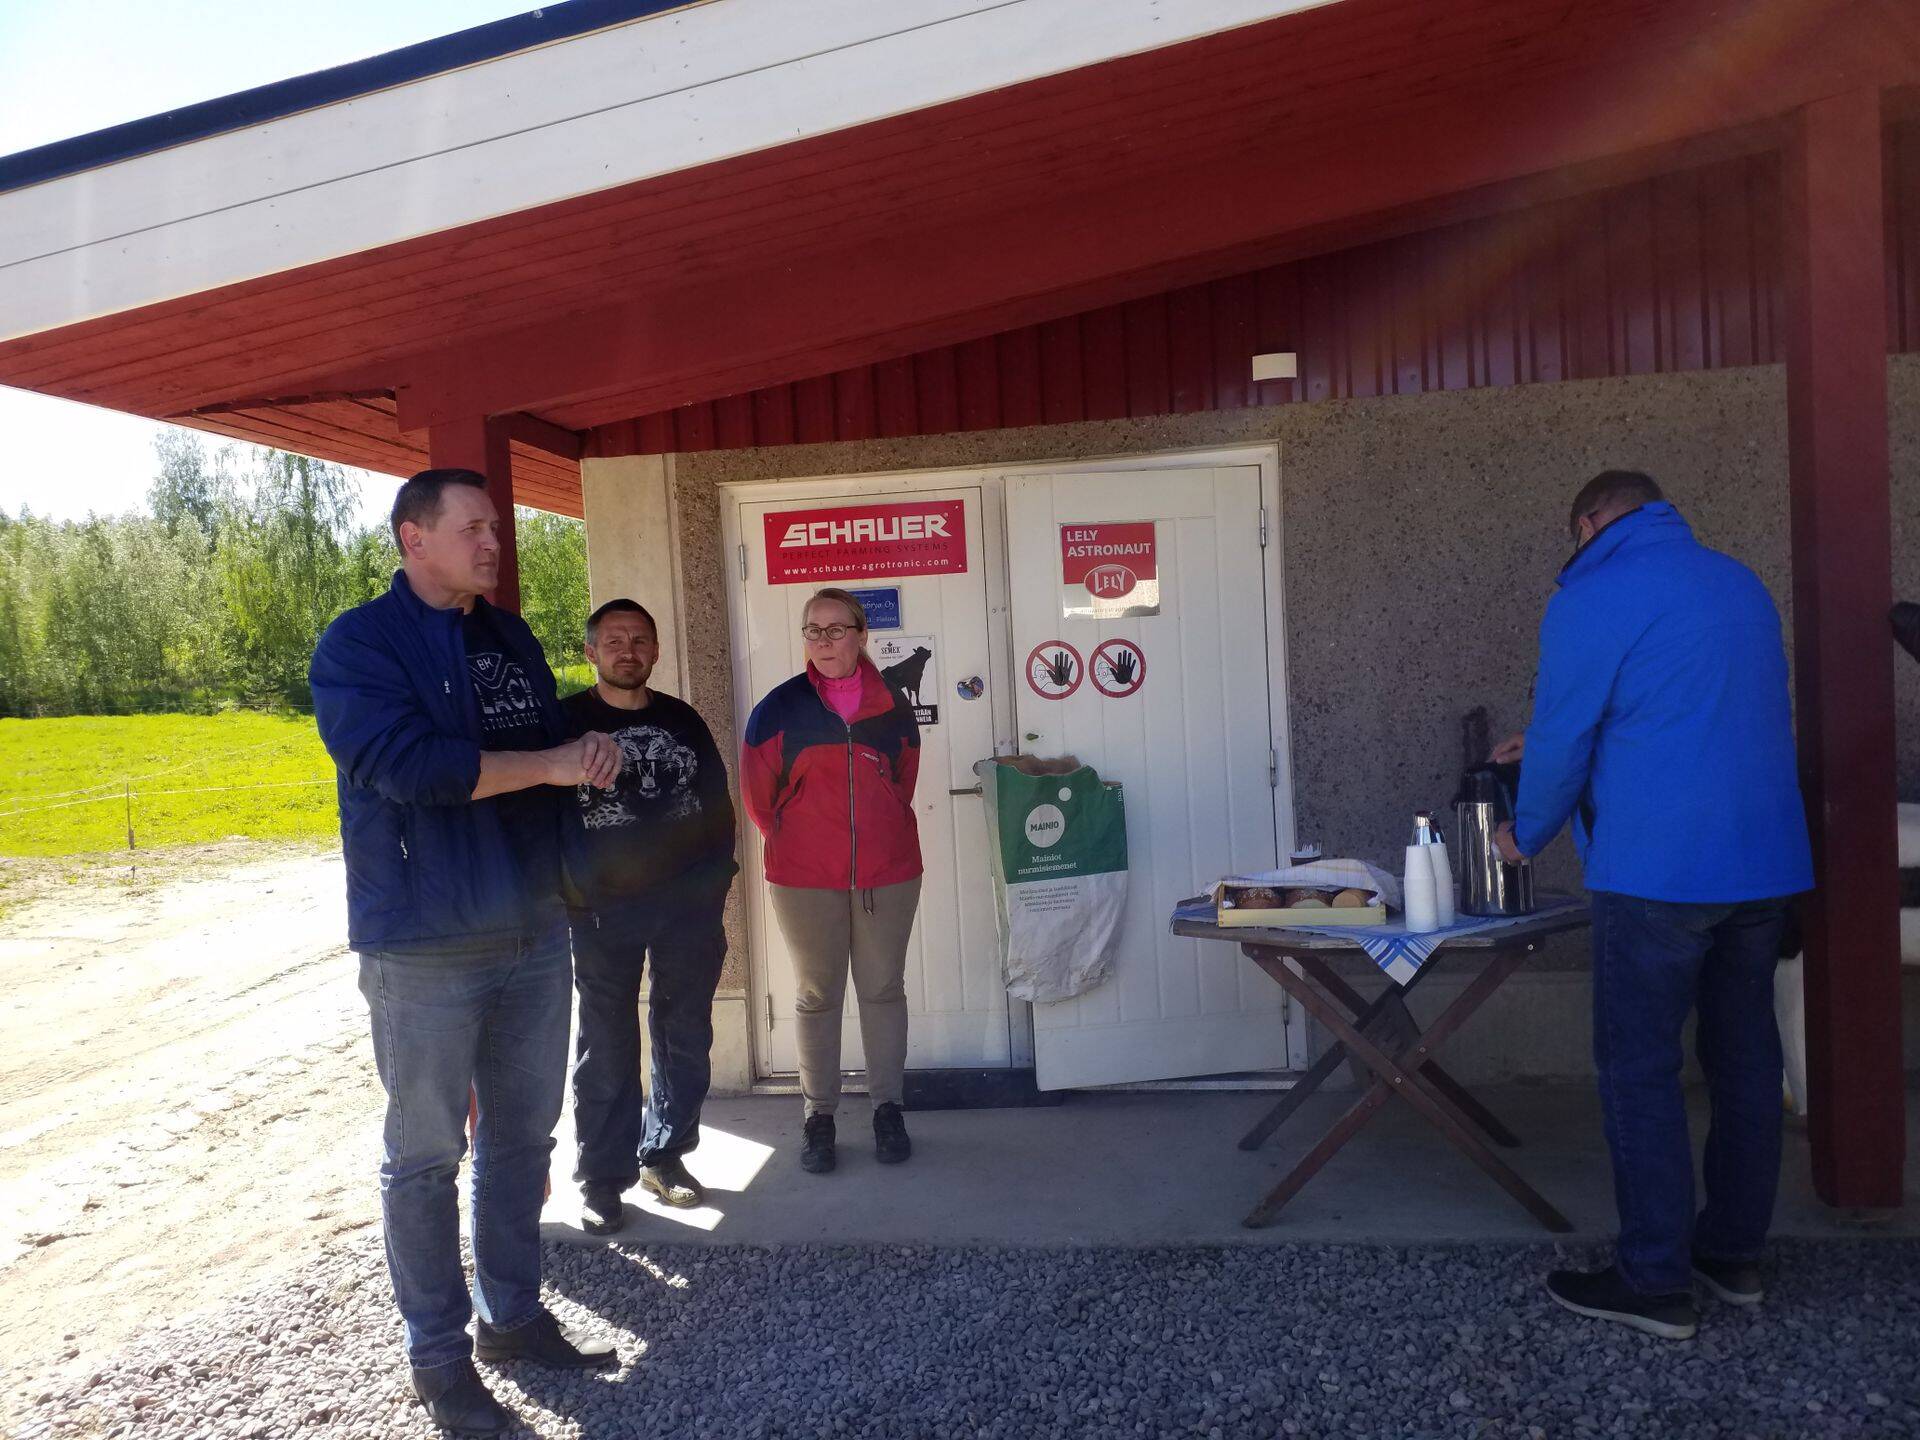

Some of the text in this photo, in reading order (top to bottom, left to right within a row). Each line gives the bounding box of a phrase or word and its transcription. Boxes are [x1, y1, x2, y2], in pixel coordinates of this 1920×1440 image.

[779, 514, 952, 548] SCHAUER
[1066, 530, 1098, 542] LELY
[782, 541, 949, 560] PERFECT FARMING SYSTEMS
[1067, 543, 1151, 557] ASTRONAUT
[783, 558, 950, 576] www.schauer-agrotronic.com
[1094, 569, 1126, 593] LELY
[880, 646, 901, 654] SEMEX
[1030, 821, 1060, 832] MAINIO
